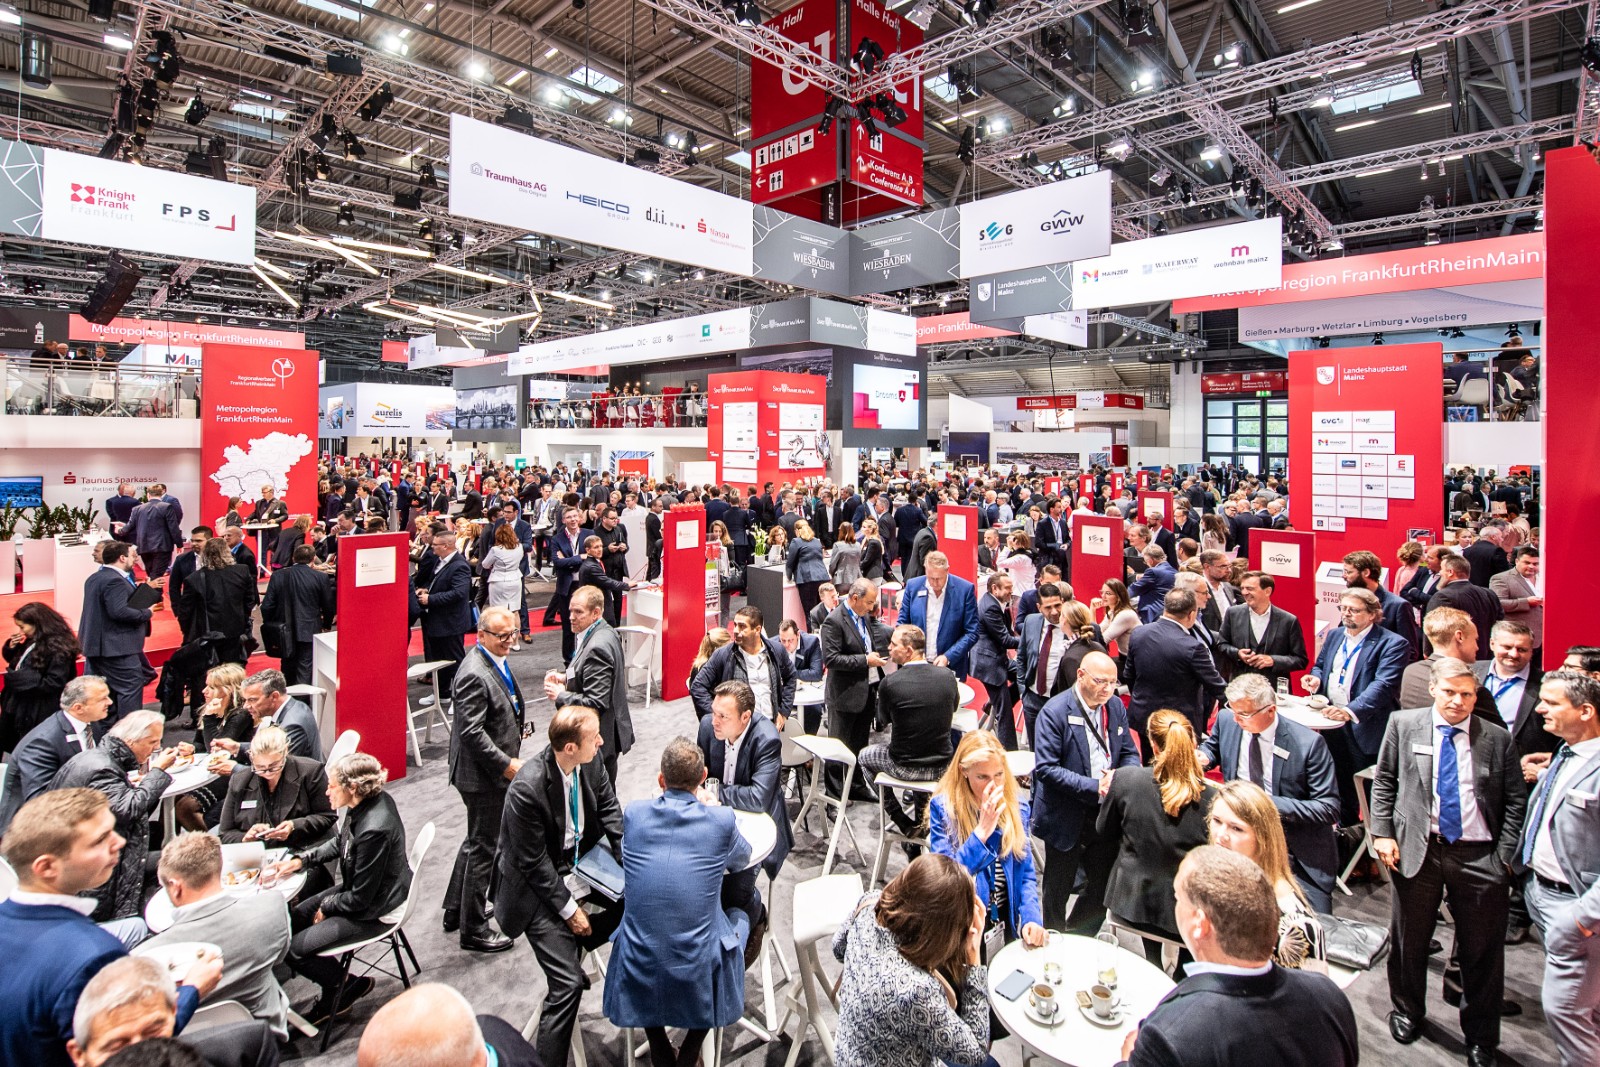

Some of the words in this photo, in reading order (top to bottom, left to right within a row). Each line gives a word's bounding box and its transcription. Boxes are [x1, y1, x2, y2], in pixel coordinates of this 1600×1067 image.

[783, 7, 803, 30] Hall
[485, 169, 532, 188] Traumhaus
[533, 182, 547, 192] AG
[98, 187, 136, 201] Knight
[98, 198, 129, 210] Frank
[566, 190, 630, 214] HEICO
[70, 204, 134, 221] Frankfurt
[162, 203, 210, 221] FPS
[607, 211, 631, 222] GROUP
[1040, 214, 1084, 232] GWW
[793, 252, 835, 270] WIESBADEN
[863, 253, 912, 271] WIESBADEN
[1213, 260, 1245, 269] wohnbau
[1247, 256, 1268, 265] mainz
[1342, 249, 1540, 284] FrankfurtRheinMain
[1101, 269, 1129, 277] MAINZER
[997, 275, 1047, 290] Landeshauptstadt
[997, 287, 1014, 296] Mainz
[1245, 329, 1273, 337] Gießen
[1279, 325, 1315, 335] Marburg
[1321, 321, 1355, 331] Wetzlar
[1363, 317, 1403, 328] Limburg
[1411, 312, 1467, 325] Vogelsberg
[91, 324, 181, 341] Metropolregion
[183, 330, 283, 347] FrankfurtRheinMain
[1343, 365, 1407, 374] Landeshauptstadt
[216, 404, 278, 415] Metropolregion
[375, 408, 403, 417] aurelis
[216, 414, 293, 423] FrankfurtRheinMain
[115, 476, 157, 485] Sparkasse
